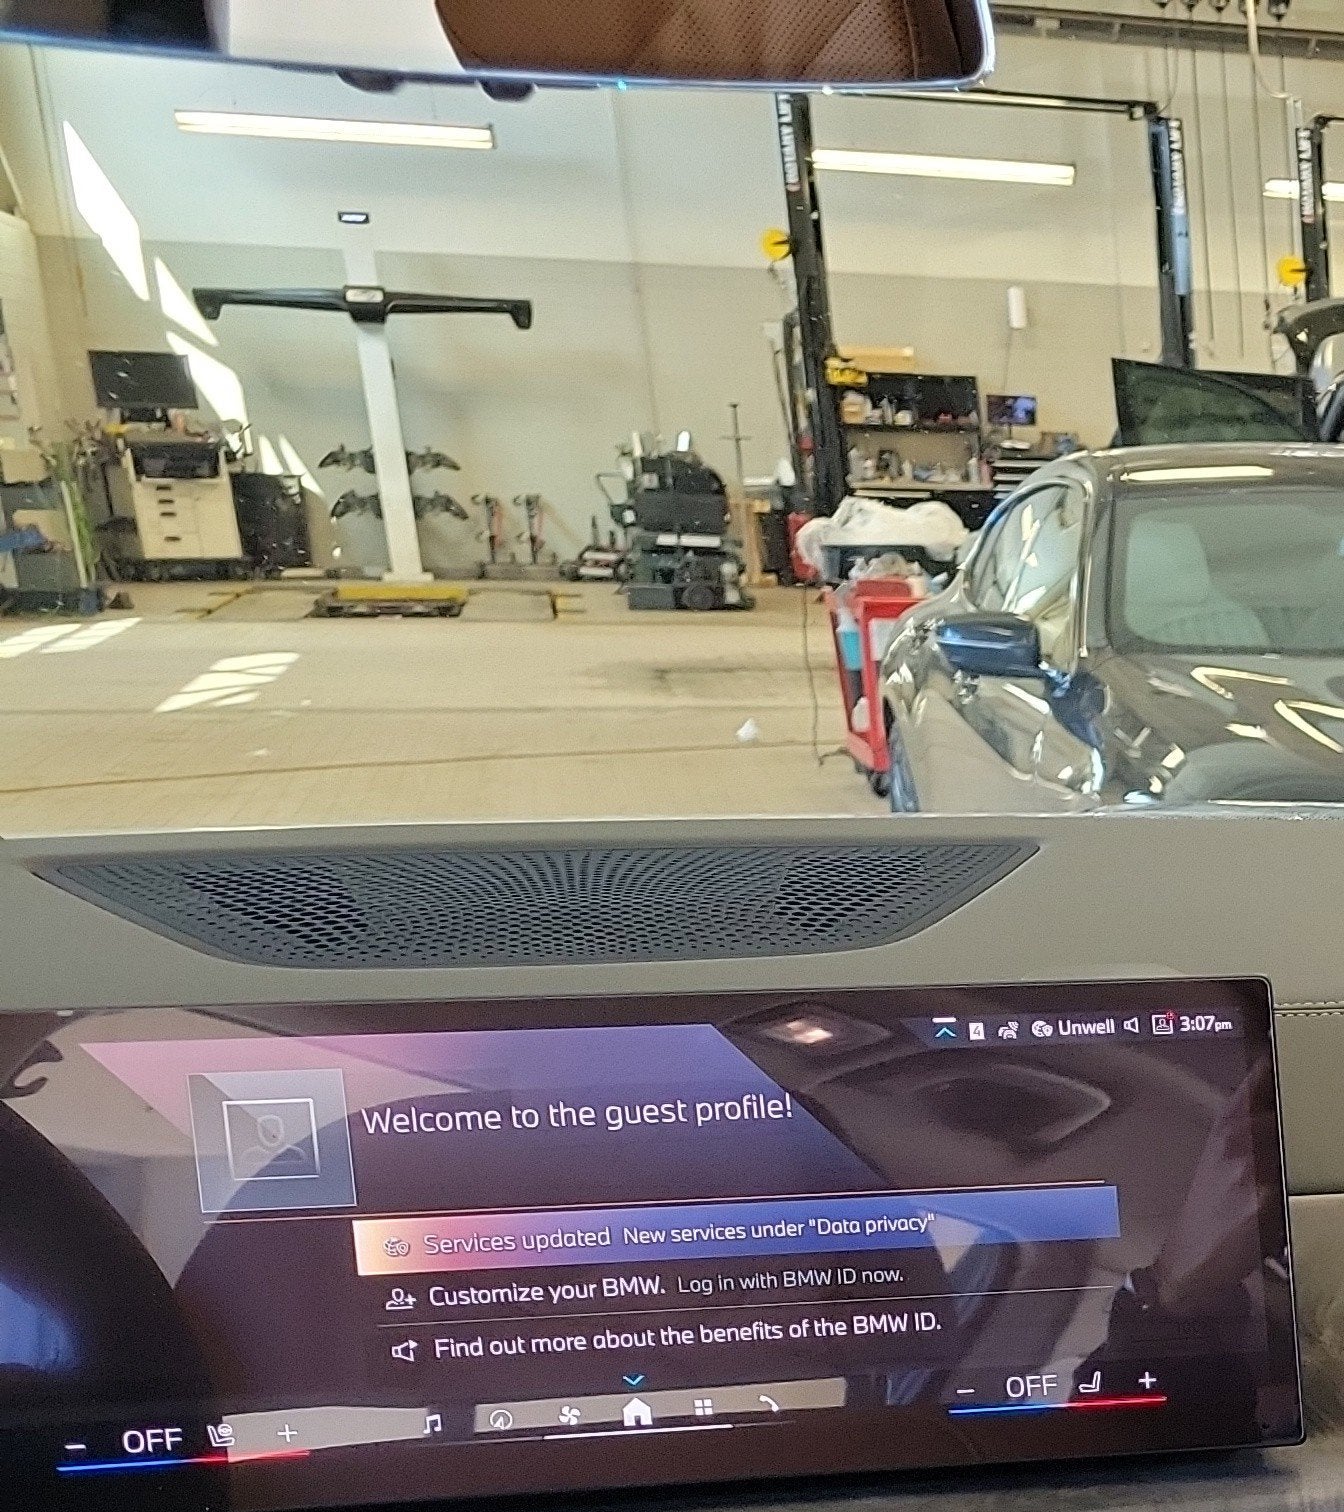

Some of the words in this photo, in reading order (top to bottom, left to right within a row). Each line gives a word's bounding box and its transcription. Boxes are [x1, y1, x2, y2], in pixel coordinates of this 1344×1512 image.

[1058, 1018, 1115, 1036] Unwell
[361, 1106, 502, 1135] Welcome
[511, 1103, 540, 1130] to
[548, 1100, 597, 1129] the
[605, 1099, 689, 1132] guest
[696, 1092, 794, 1127] profile!
[423, 1232, 516, 1255] Services
[522, 1226, 611, 1253] updated
[623, 1227, 666, 1245] New
[670, 1222, 747, 1244] services
[751, 1219, 806, 1239] under
[429, 1282, 545, 1307] Customize
[549, 1281, 598, 1305] your
[602, 1275, 666, 1298] BMW.
[677, 1275, 713, 1297] Log
[717, 1273, 734, 1291] in
[739, 1270, 779, 1290] with
[783, 1268, 832, 1288] BMW
[837, 1268, 857, 1285] ID
[862, 1268, 904, 1285] now.
[434, 1336, 484, 1359] Find
[489, 1335, 527, 1357] out
[531, 1333, 587, 1353] more
[593, 1328, 657, 1350] about
[660, 1325, 695, 1347] the
[700, 1319, 784, 1344] benefits
[788, 1318, 811, 1339] of
[813, 1318, 848, 1338] the
[852, 1312, 908, 1335] BMW
[913, 1311, 943, 1332] ID.
[1005, 1374, 1058, 1398] OFF
[122, 1429, 183, 1455] OFF
